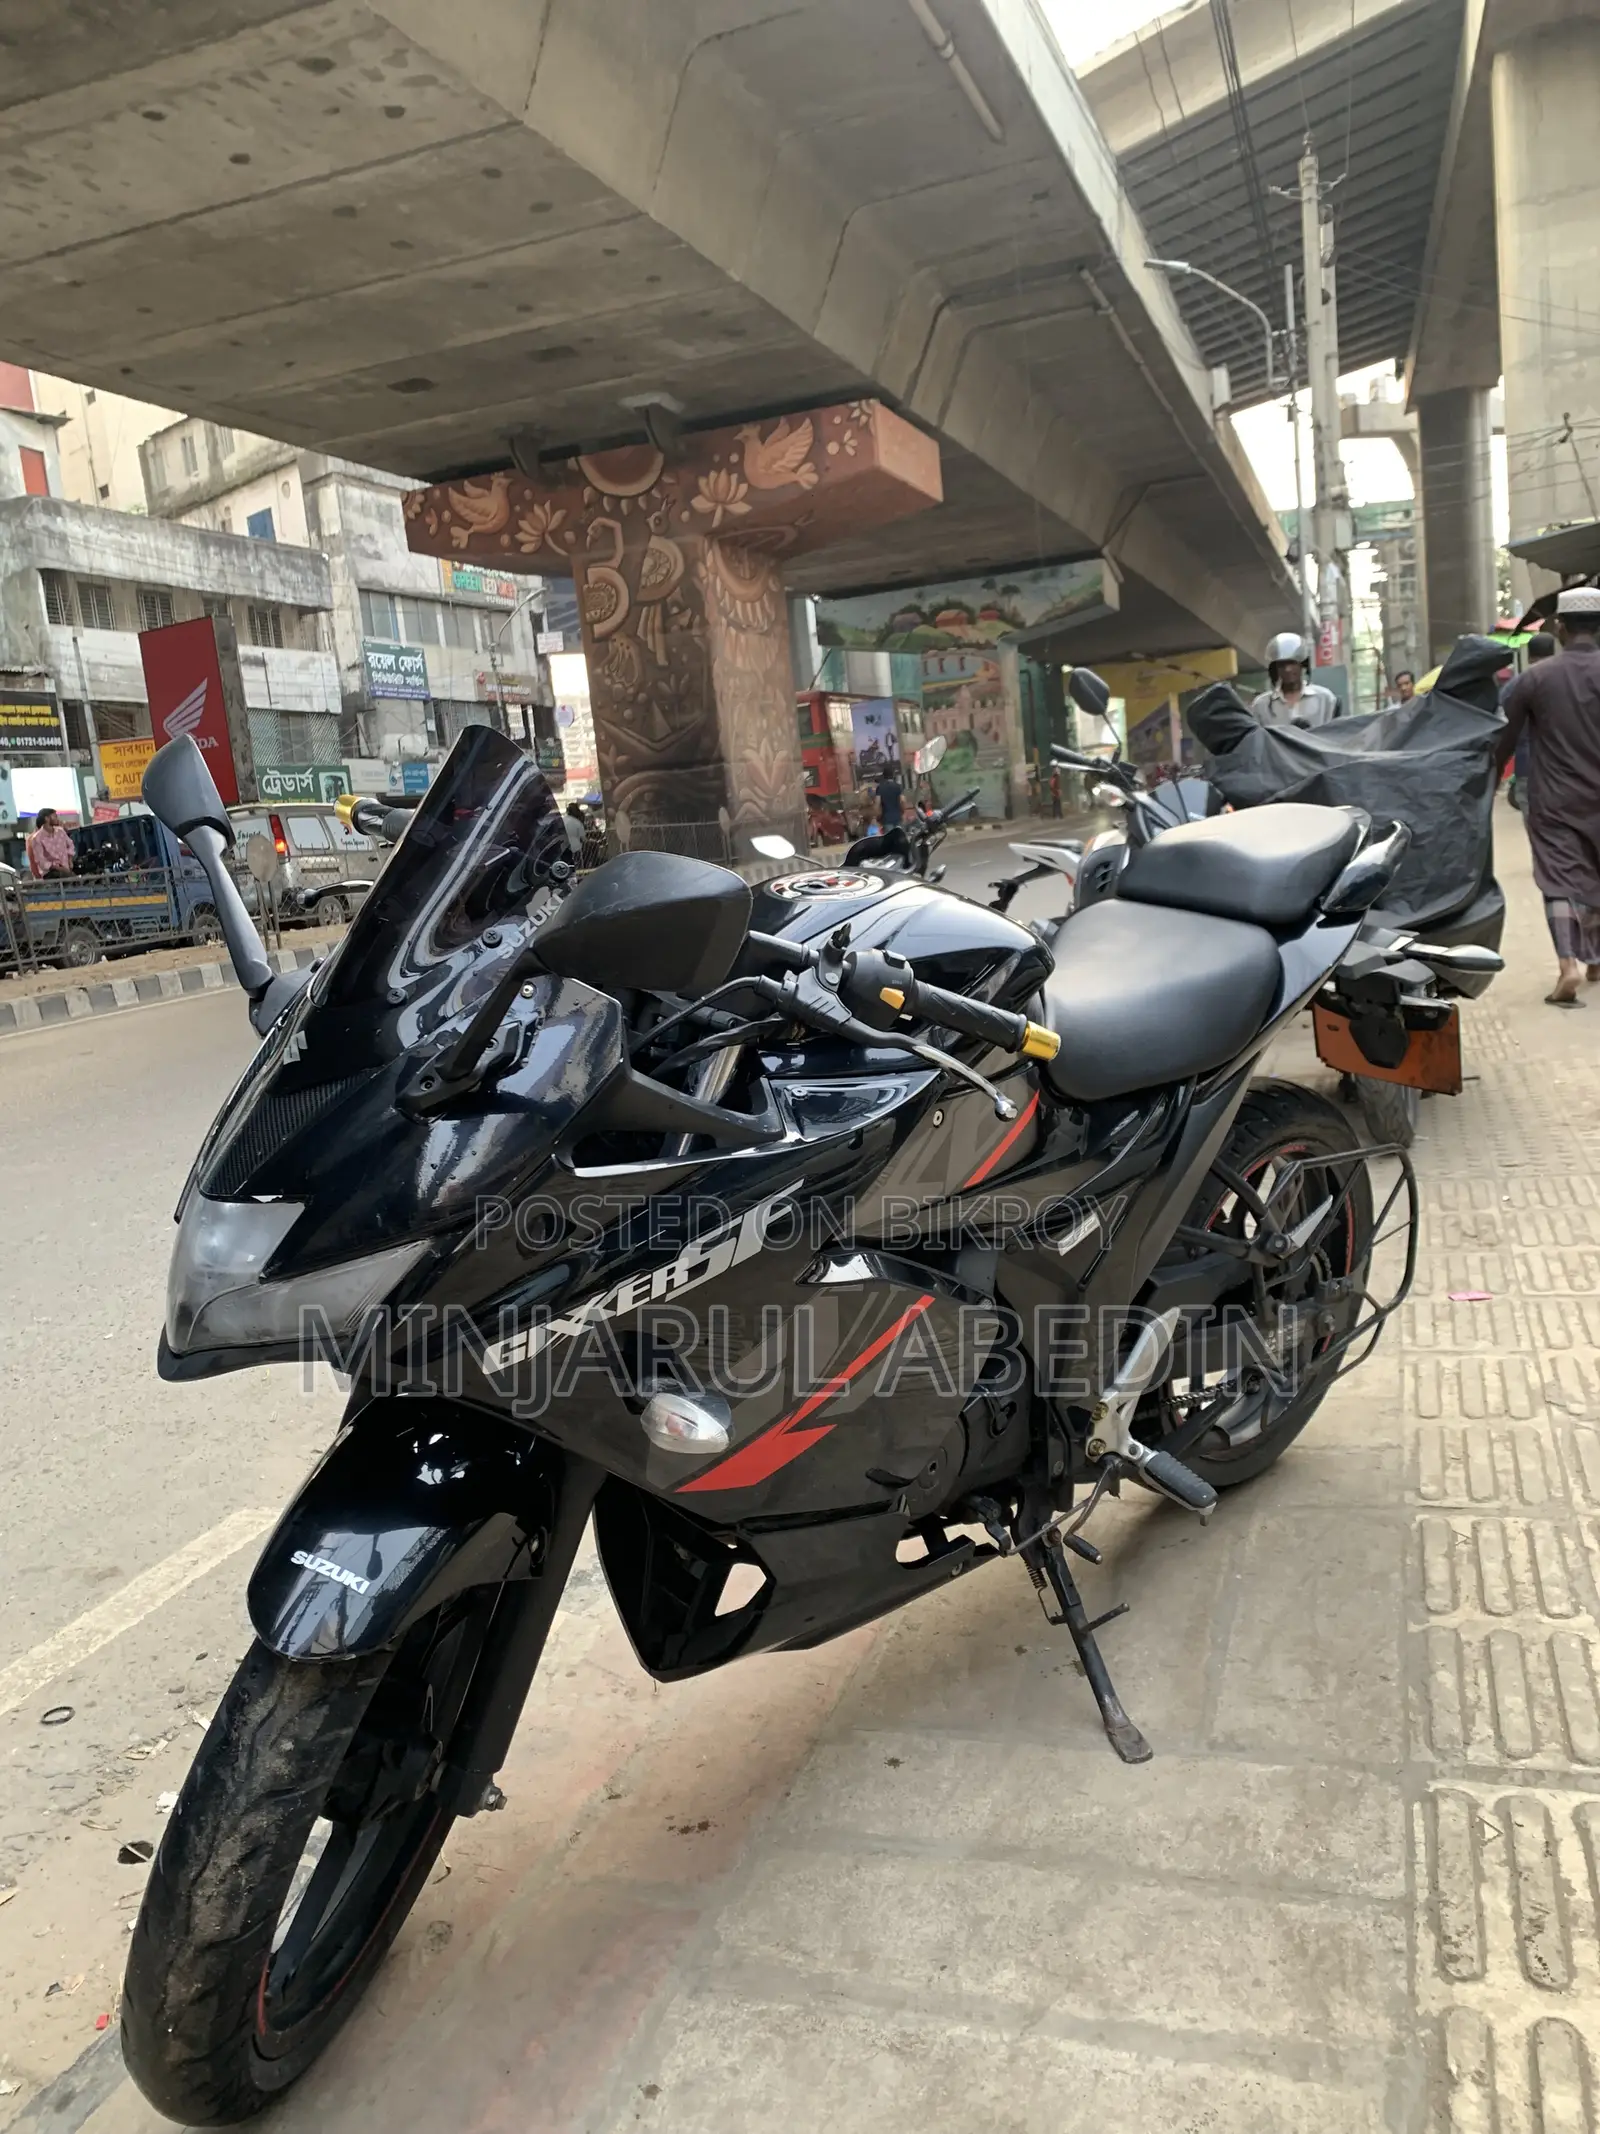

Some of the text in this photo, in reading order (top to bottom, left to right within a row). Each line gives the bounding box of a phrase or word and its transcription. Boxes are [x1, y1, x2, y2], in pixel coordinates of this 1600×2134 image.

[112, 742, 154, 757] সাবধান
[115, 771, 143, 785] CAUT
[262, 767, 314, 796] ট্রেডার্স
[498, 892, 565, 960] SUZUKI
[290, 1550, 371, 1595] SUZUKI
